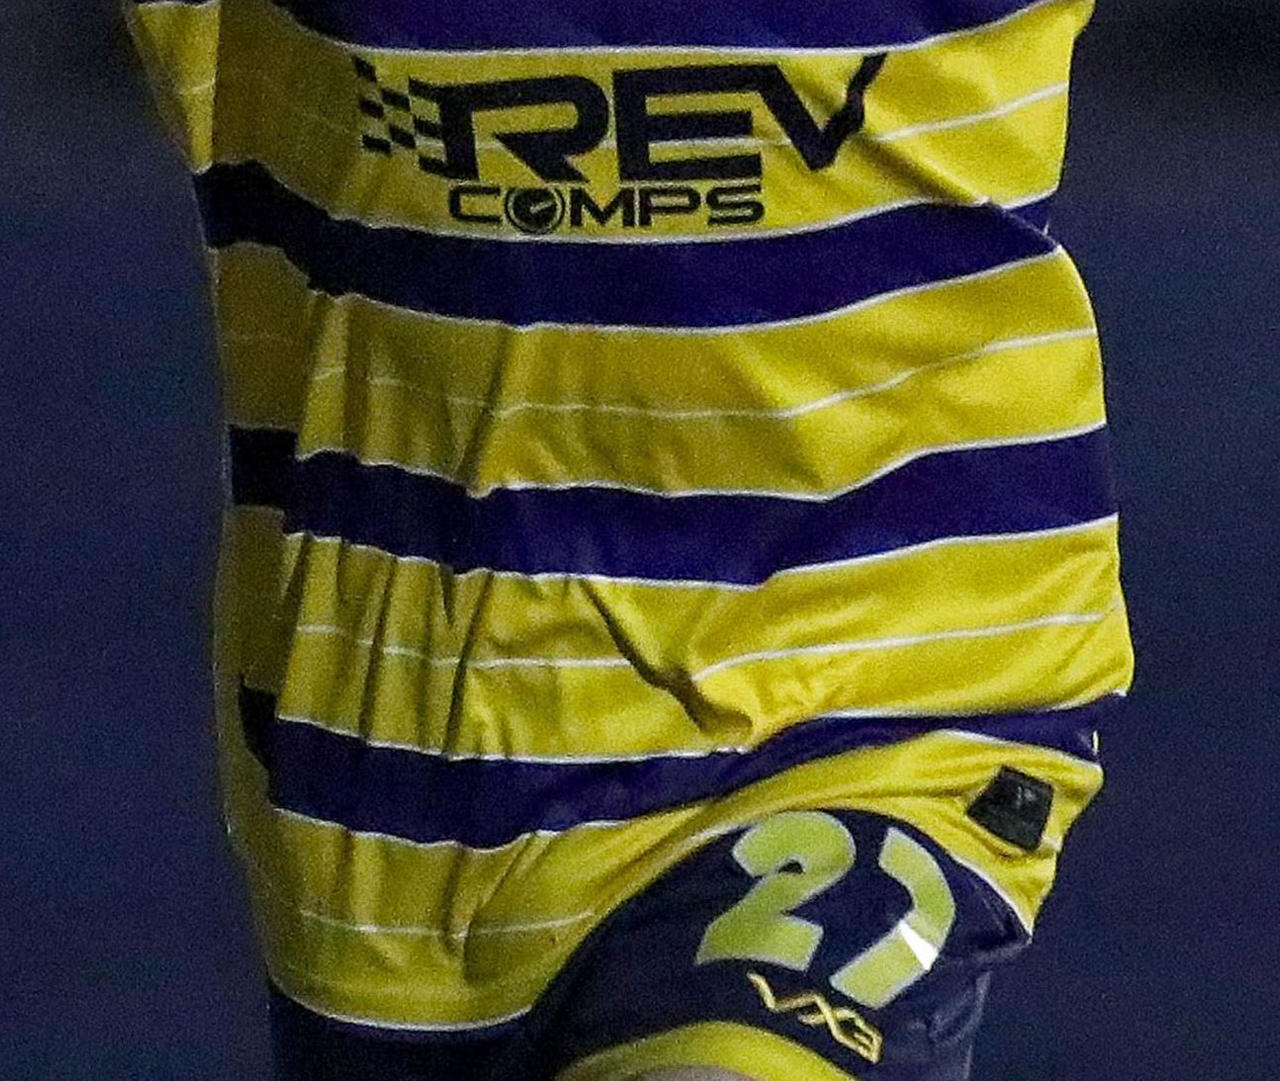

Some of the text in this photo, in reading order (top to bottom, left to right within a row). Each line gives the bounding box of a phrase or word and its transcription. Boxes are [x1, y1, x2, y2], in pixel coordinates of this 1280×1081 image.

[408, 52, 888, 184] REV
[449, 184, 766, 235] COMPS
[695, 810, 956, 1010] 27
[746, 970, 883, 1064] VX3
